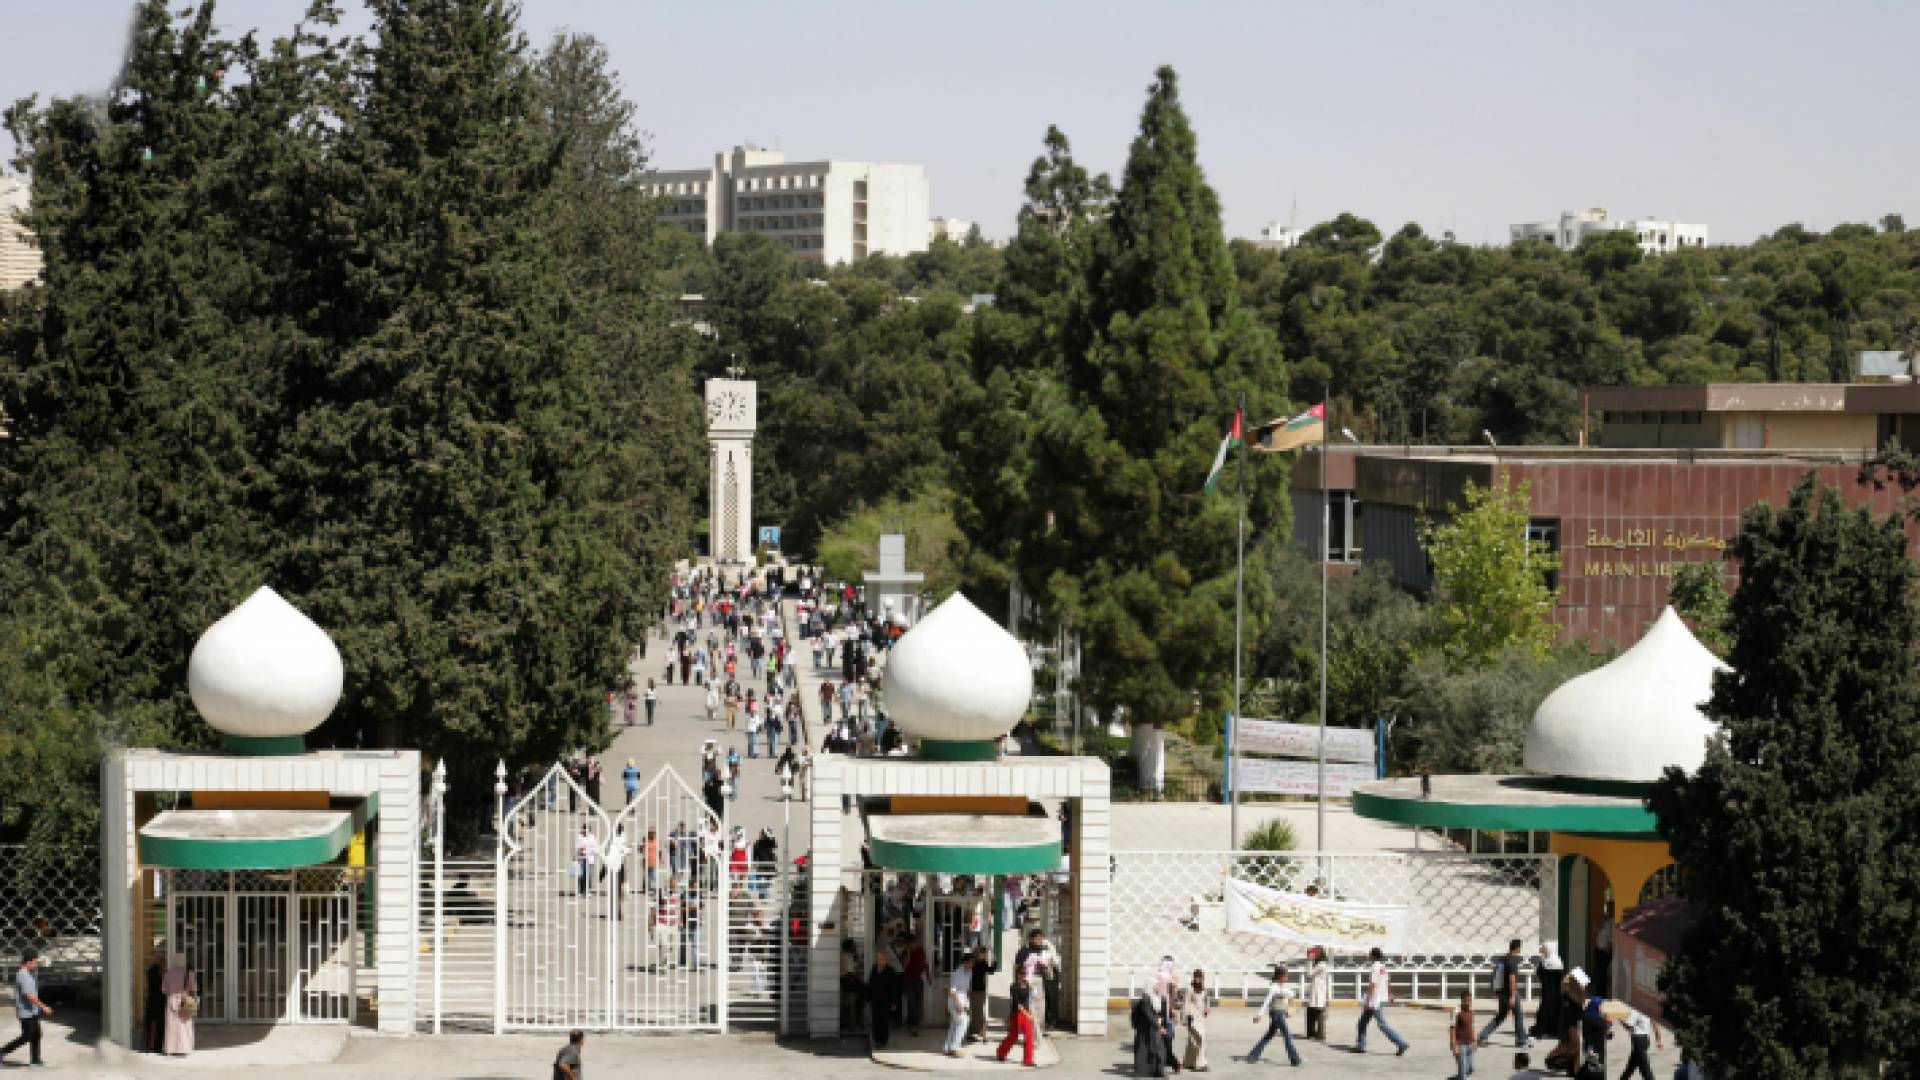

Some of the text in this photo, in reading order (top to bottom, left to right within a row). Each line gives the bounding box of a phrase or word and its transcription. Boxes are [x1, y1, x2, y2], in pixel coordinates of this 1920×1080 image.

[1585, 529, 1726, 551] مكتبة الجامعة
[1584, 562, 1635, 576] MAIN
